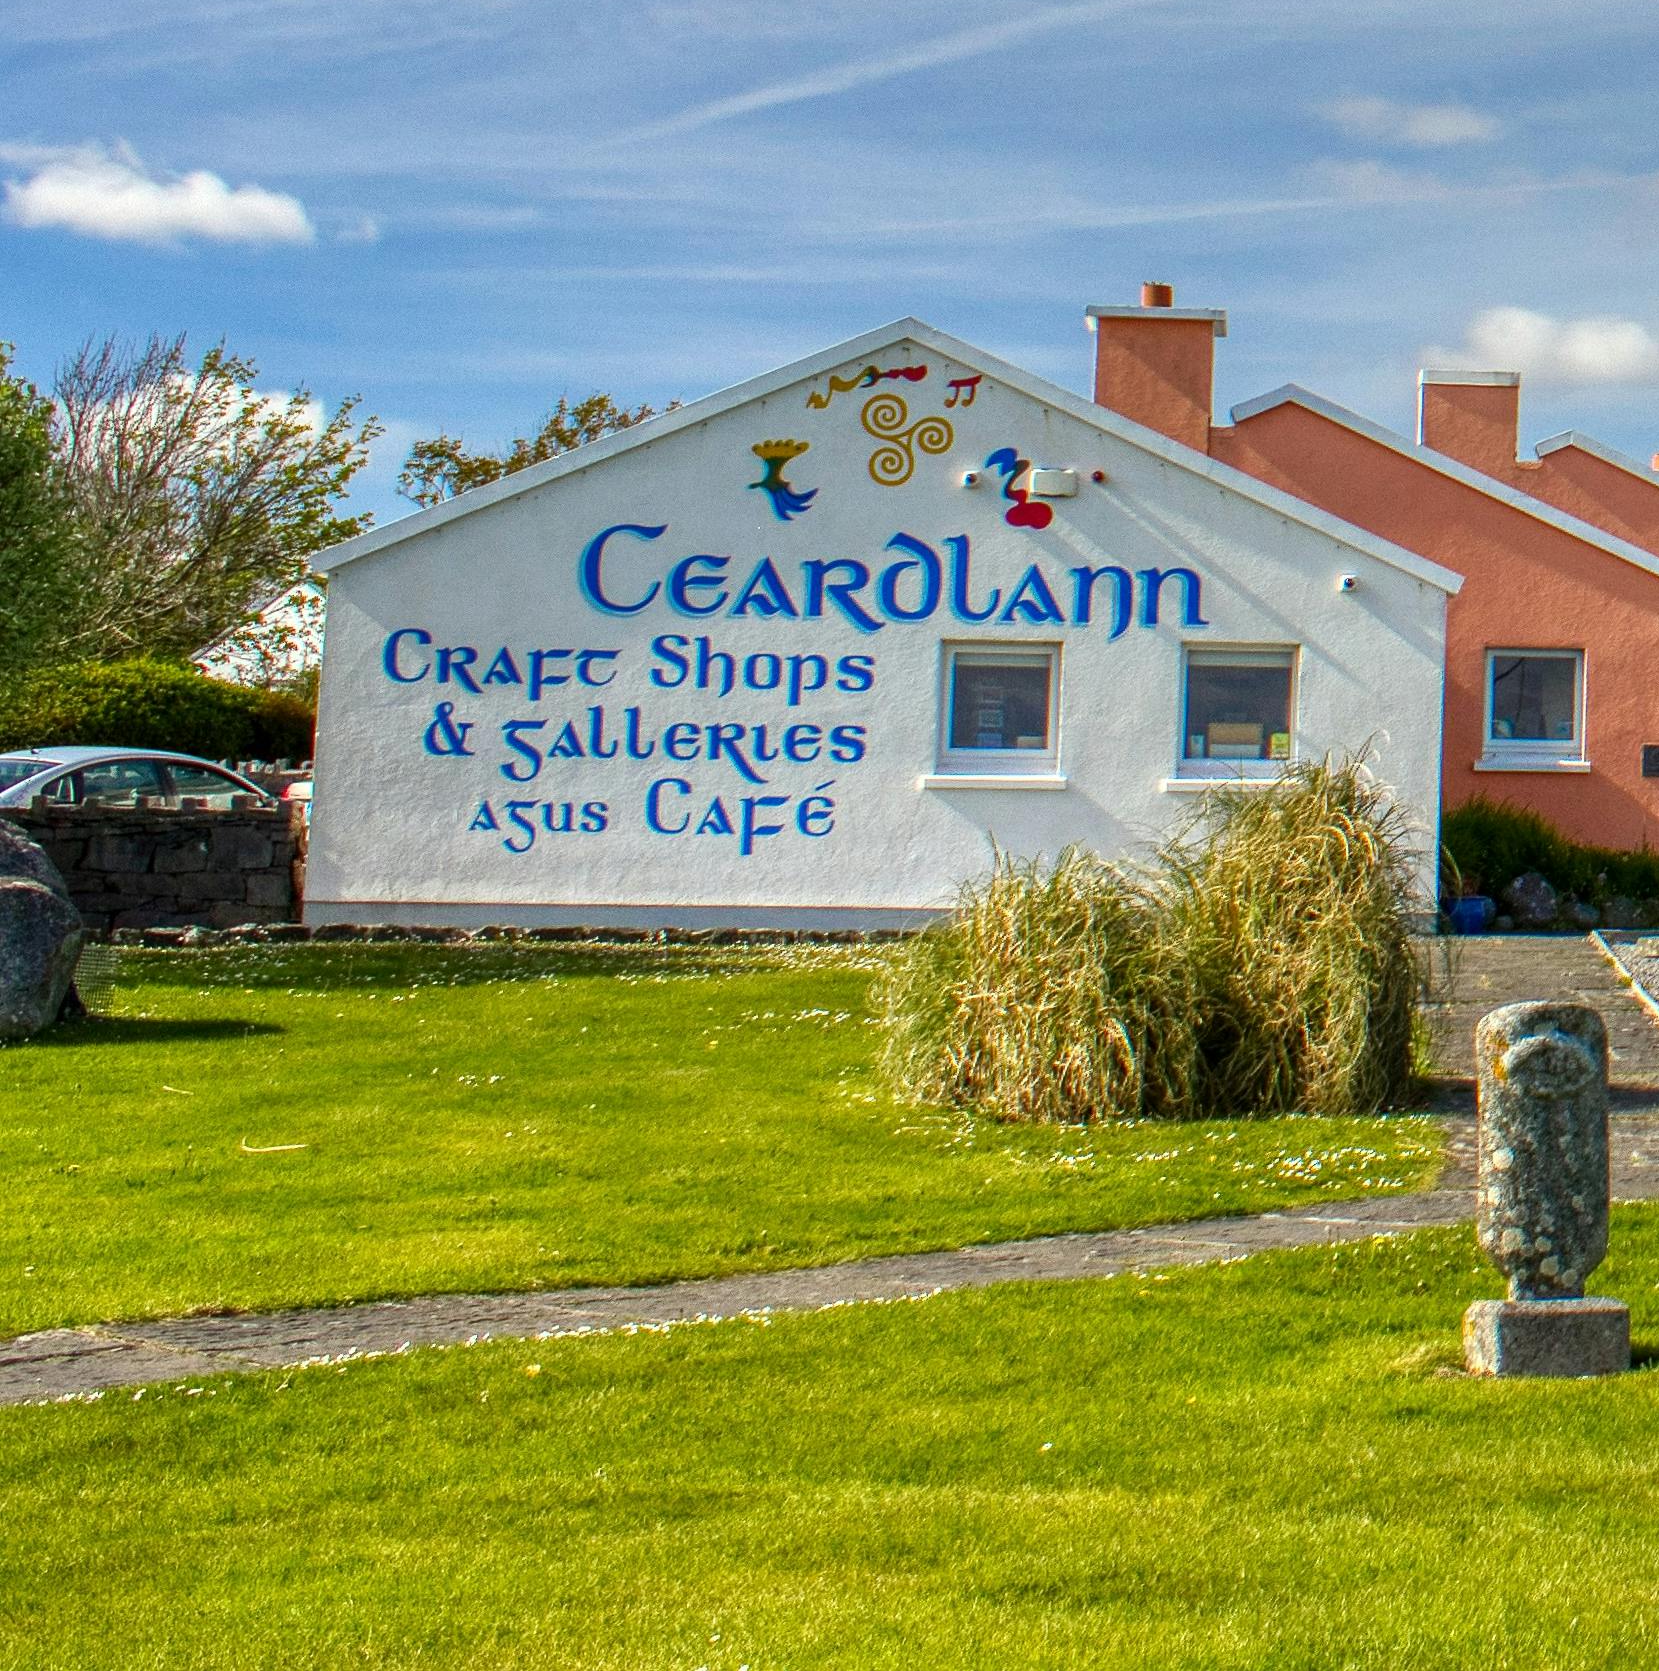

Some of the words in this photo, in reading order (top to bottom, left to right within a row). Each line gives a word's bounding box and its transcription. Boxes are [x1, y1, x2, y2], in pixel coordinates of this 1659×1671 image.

[380, 628, 619, 704] Craft
[647, 634, 876, 708] Shops
[421, 701, 474, 759] &
[498, 704, 868, 787] Galleries
[468, 800, 608, 855] agus
[642, 776, 837, 858] Café
